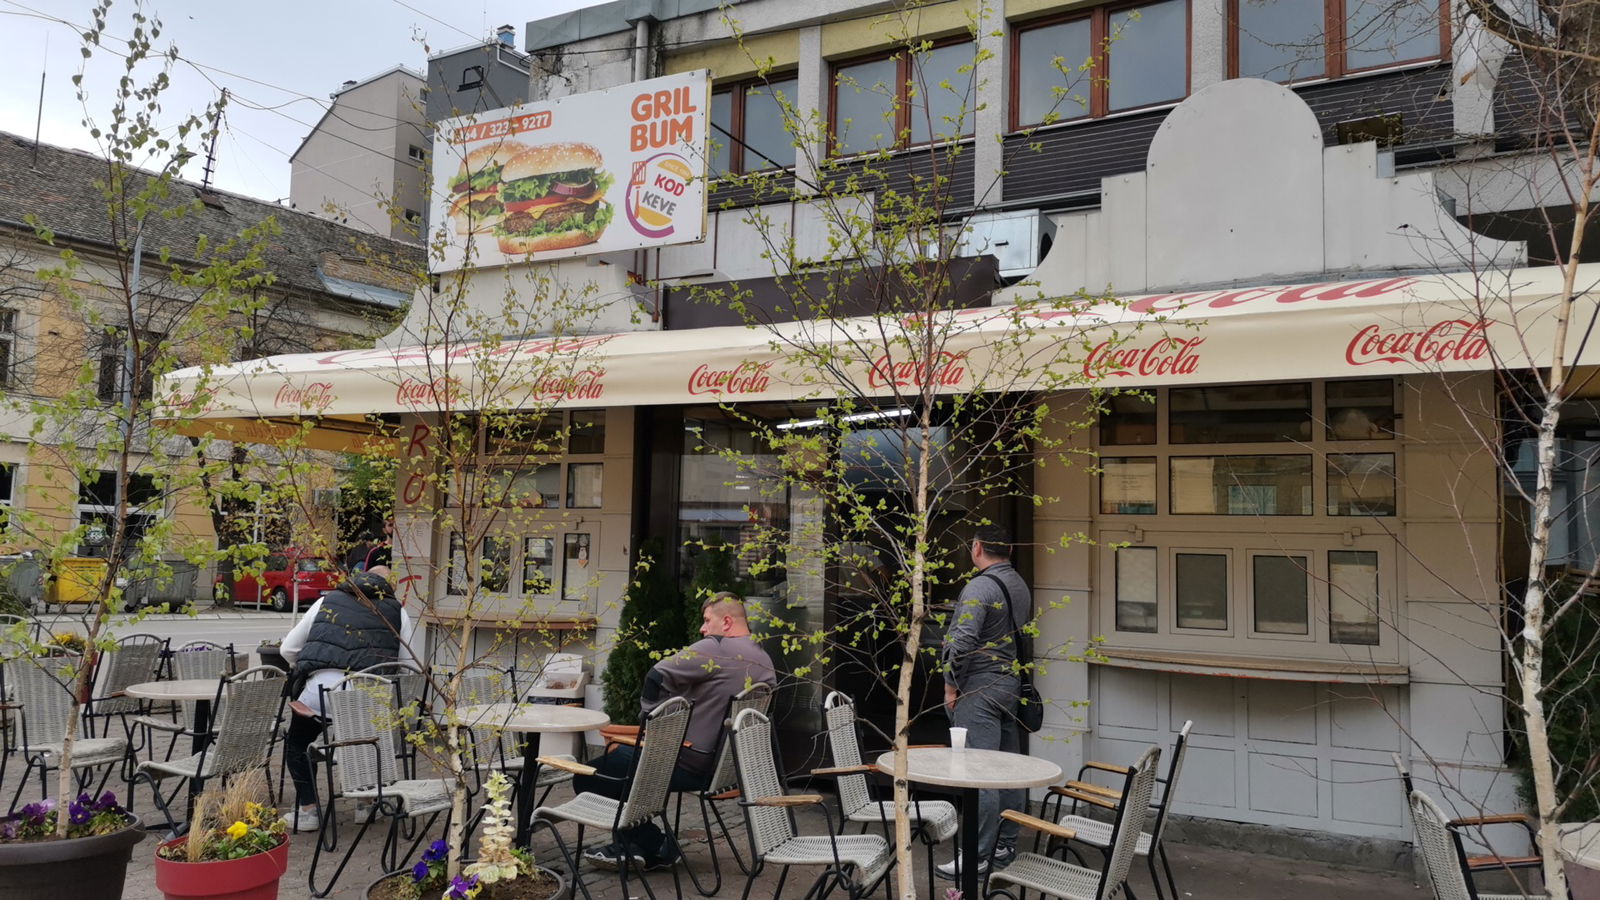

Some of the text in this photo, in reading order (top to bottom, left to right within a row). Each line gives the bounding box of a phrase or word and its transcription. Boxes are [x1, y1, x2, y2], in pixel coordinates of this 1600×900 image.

[631, 86, 697, 122] GRIL
[489, 121, 510, 137] 323
[522, 114, 549, 130] 9277
[630, 115, 693, 152] BUM
[654, 173, 685, 197] KOD
[641, 190, 677, 216] KEVE
[1083, 336, 1208, 379] Coca-Cola
[1346, 319, 1496, 365] Coca-Cola
[687, 361, 775, 395] Coca-Cola
